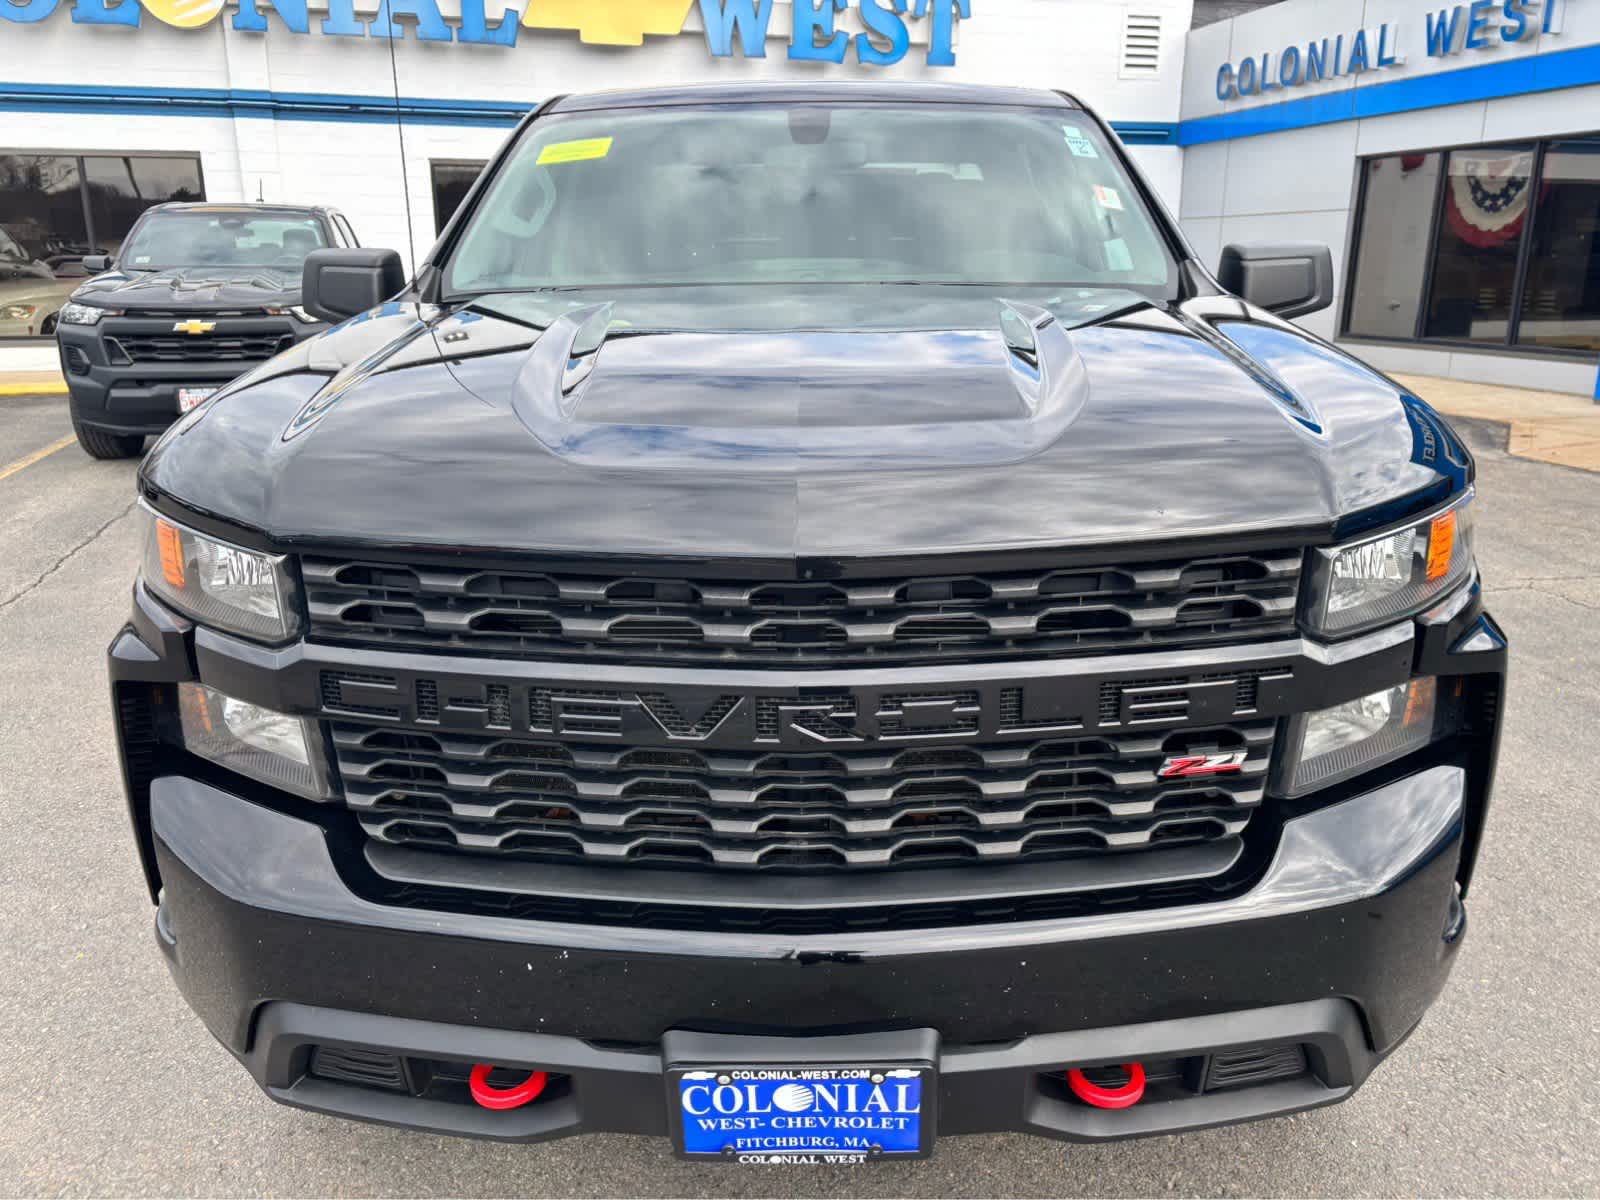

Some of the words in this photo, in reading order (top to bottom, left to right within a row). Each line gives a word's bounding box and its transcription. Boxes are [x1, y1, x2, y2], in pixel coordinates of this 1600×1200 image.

[698, 0, 971, 67] WEST
[1216, 23, 1402, 100] COLONIAL
[319, 665, 1294, 742] CHEVROLET
[1157, 752, 1248, 778] Z71
[731, 1069, 871, 1080] COLONIAL-WEST.COM
[681, 1083, 921, 1115] COLONIAL
[770, 1116, 910, 1130] CHEVROLET
[735, 1136, 840, 1149] FITCHBURG,
[843, 1136, 870, 1148] MA
[738, 1154, 820, 1165] COLONIAL
[823, 1154, 868, 1164] WEST
